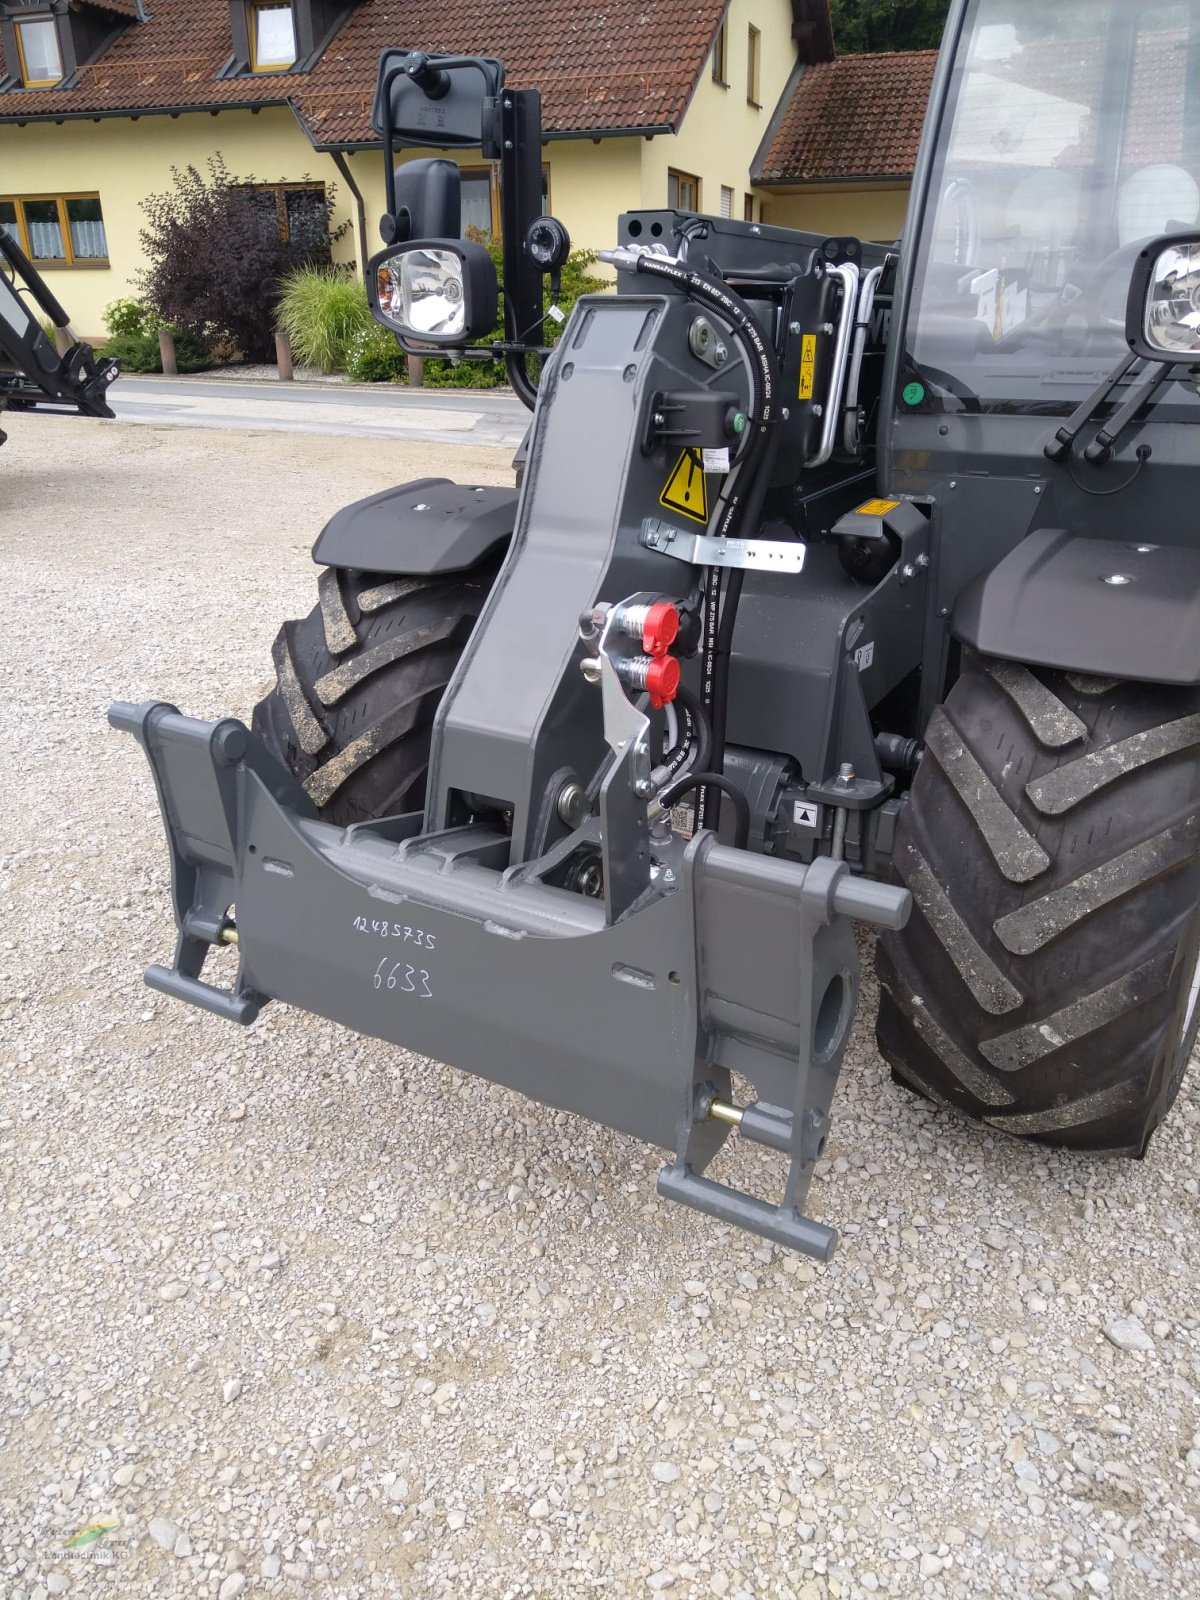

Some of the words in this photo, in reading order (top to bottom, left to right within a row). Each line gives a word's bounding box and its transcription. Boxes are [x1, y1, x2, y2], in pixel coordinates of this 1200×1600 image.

[753, 337, 764, 352] BAR
[353, 916, 436, 949] 12485735
[374, 957, 433, 997] 6633
